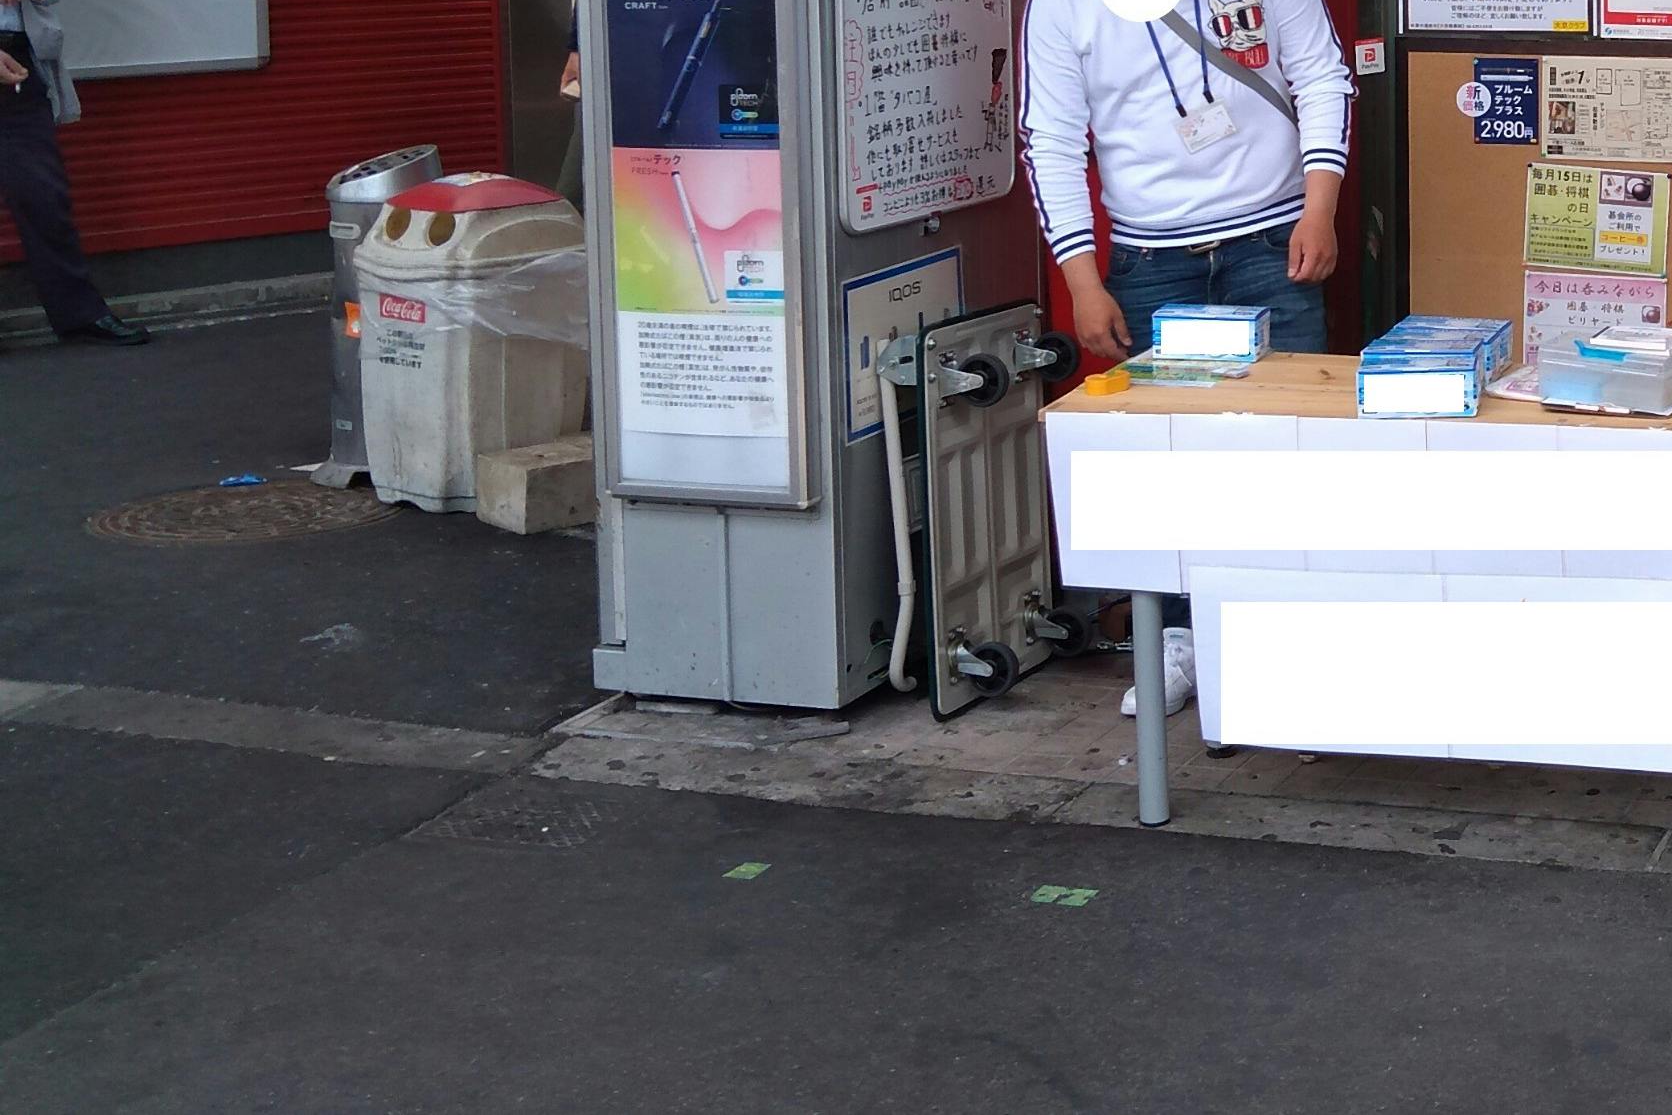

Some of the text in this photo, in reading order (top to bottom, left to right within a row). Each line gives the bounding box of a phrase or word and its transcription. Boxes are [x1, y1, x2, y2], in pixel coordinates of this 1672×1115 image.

[624, 2, 657, 10] CRAFT
[1466, 86, 1481, 100] 新
[1494, 85, 1532, 95] プルーム
[1463, 100, 1485, 112] 価格
[1494, 96, 1521, 105] テック
[1494, 105, 1523, 116] プラス
[654, 154, 681, 165] テック
[1532, 168, 1593, 184] 毎月15日は
[1534, 183, 1590, 199] 囲碁・将棋
[1567, 203, 1589, 214] の日
[1530, 213, 1593, 227] キャンペーン
[1608, 211, 1642, 221] 碁会所の
[1608, 222, 1641, 232] ご利用で
[889, 280, 922, 303] IQOS
[1534, 280, 1655, 299] 今日は呑みながら
[1568, 315, 1624, 326] ビリヤード
